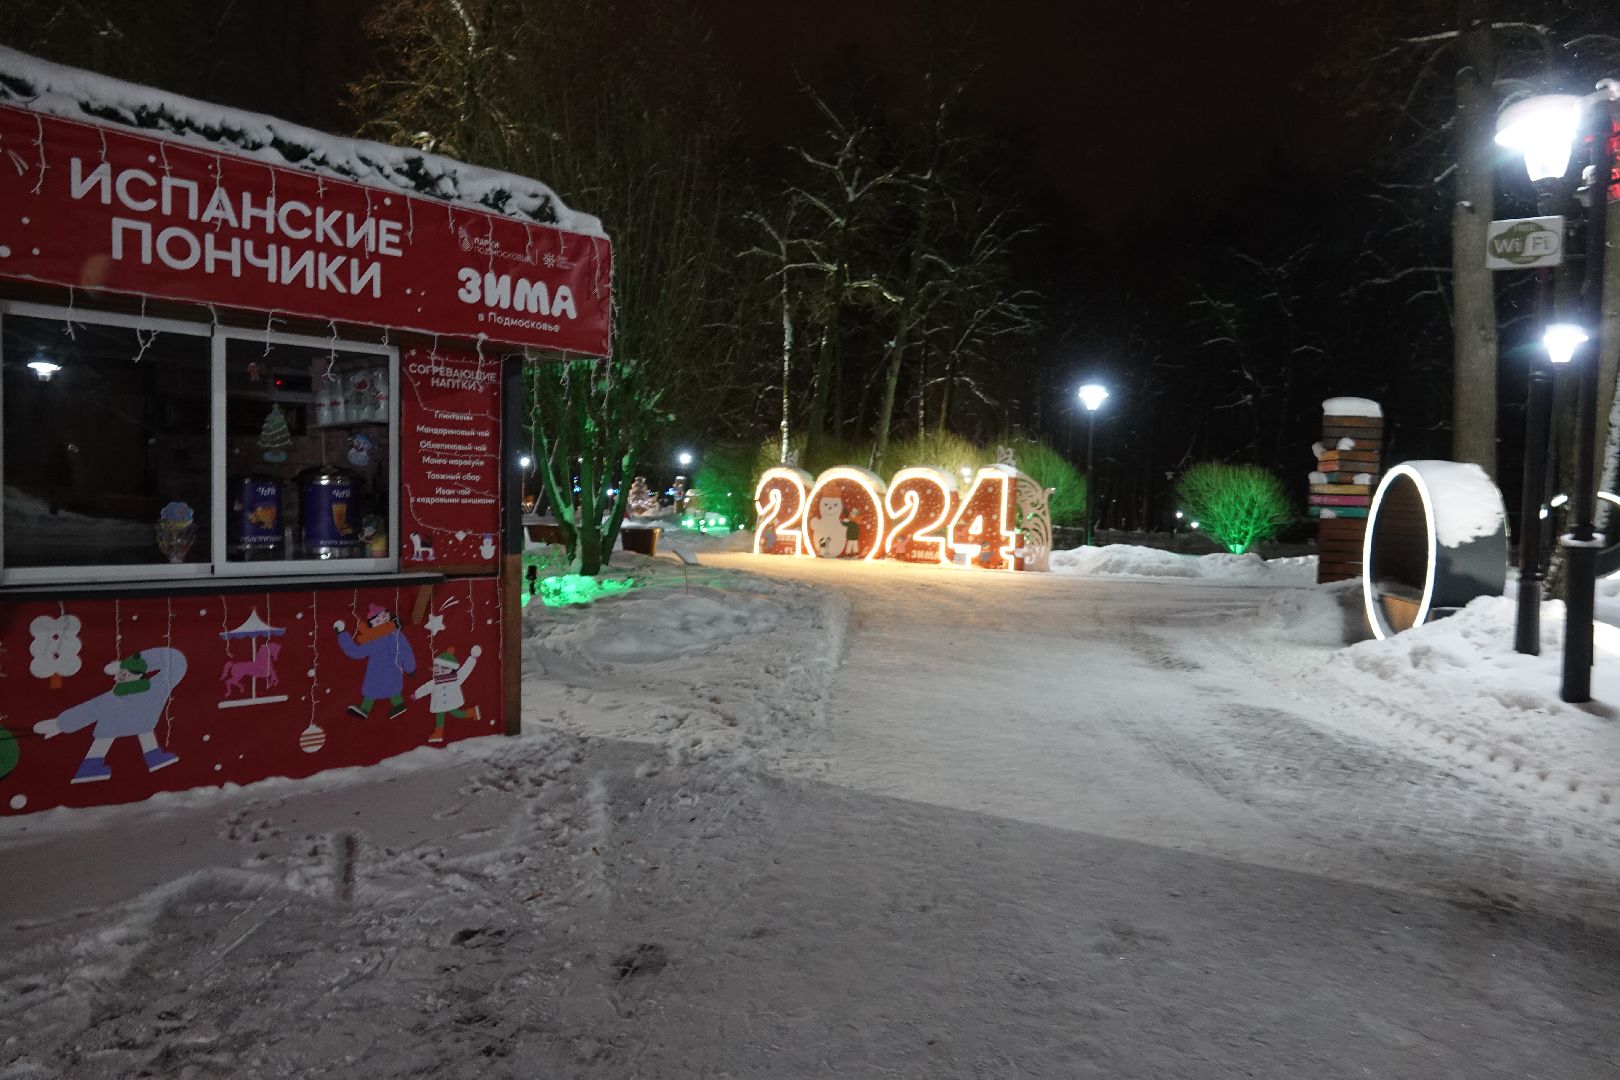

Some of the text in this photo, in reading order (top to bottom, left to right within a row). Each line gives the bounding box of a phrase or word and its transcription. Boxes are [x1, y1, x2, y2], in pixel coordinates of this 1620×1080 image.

[70, 157, 404, 258] ИСПАНСКИЕ
[111, 216, 382, 298] ПОНЧИКИ
[457, 267, 577, 320] ЗИМА
[478, 311, 561, 333] в Подмосковье
[409, 364, 496, 382] СОГРЕВАЮЩИЕ
[416, 425, 490, 437] Мандариновый чай
[420, 440, 487, 452] Облепиховый чай
[422, 456, 447, 464] Манго
[462, 473, 481, 482] сбор
[435, 487, 471, 495] Иван чай
[416, 496, 459, 505] кедровыми
[754, 466, 1017, 571] 2024
